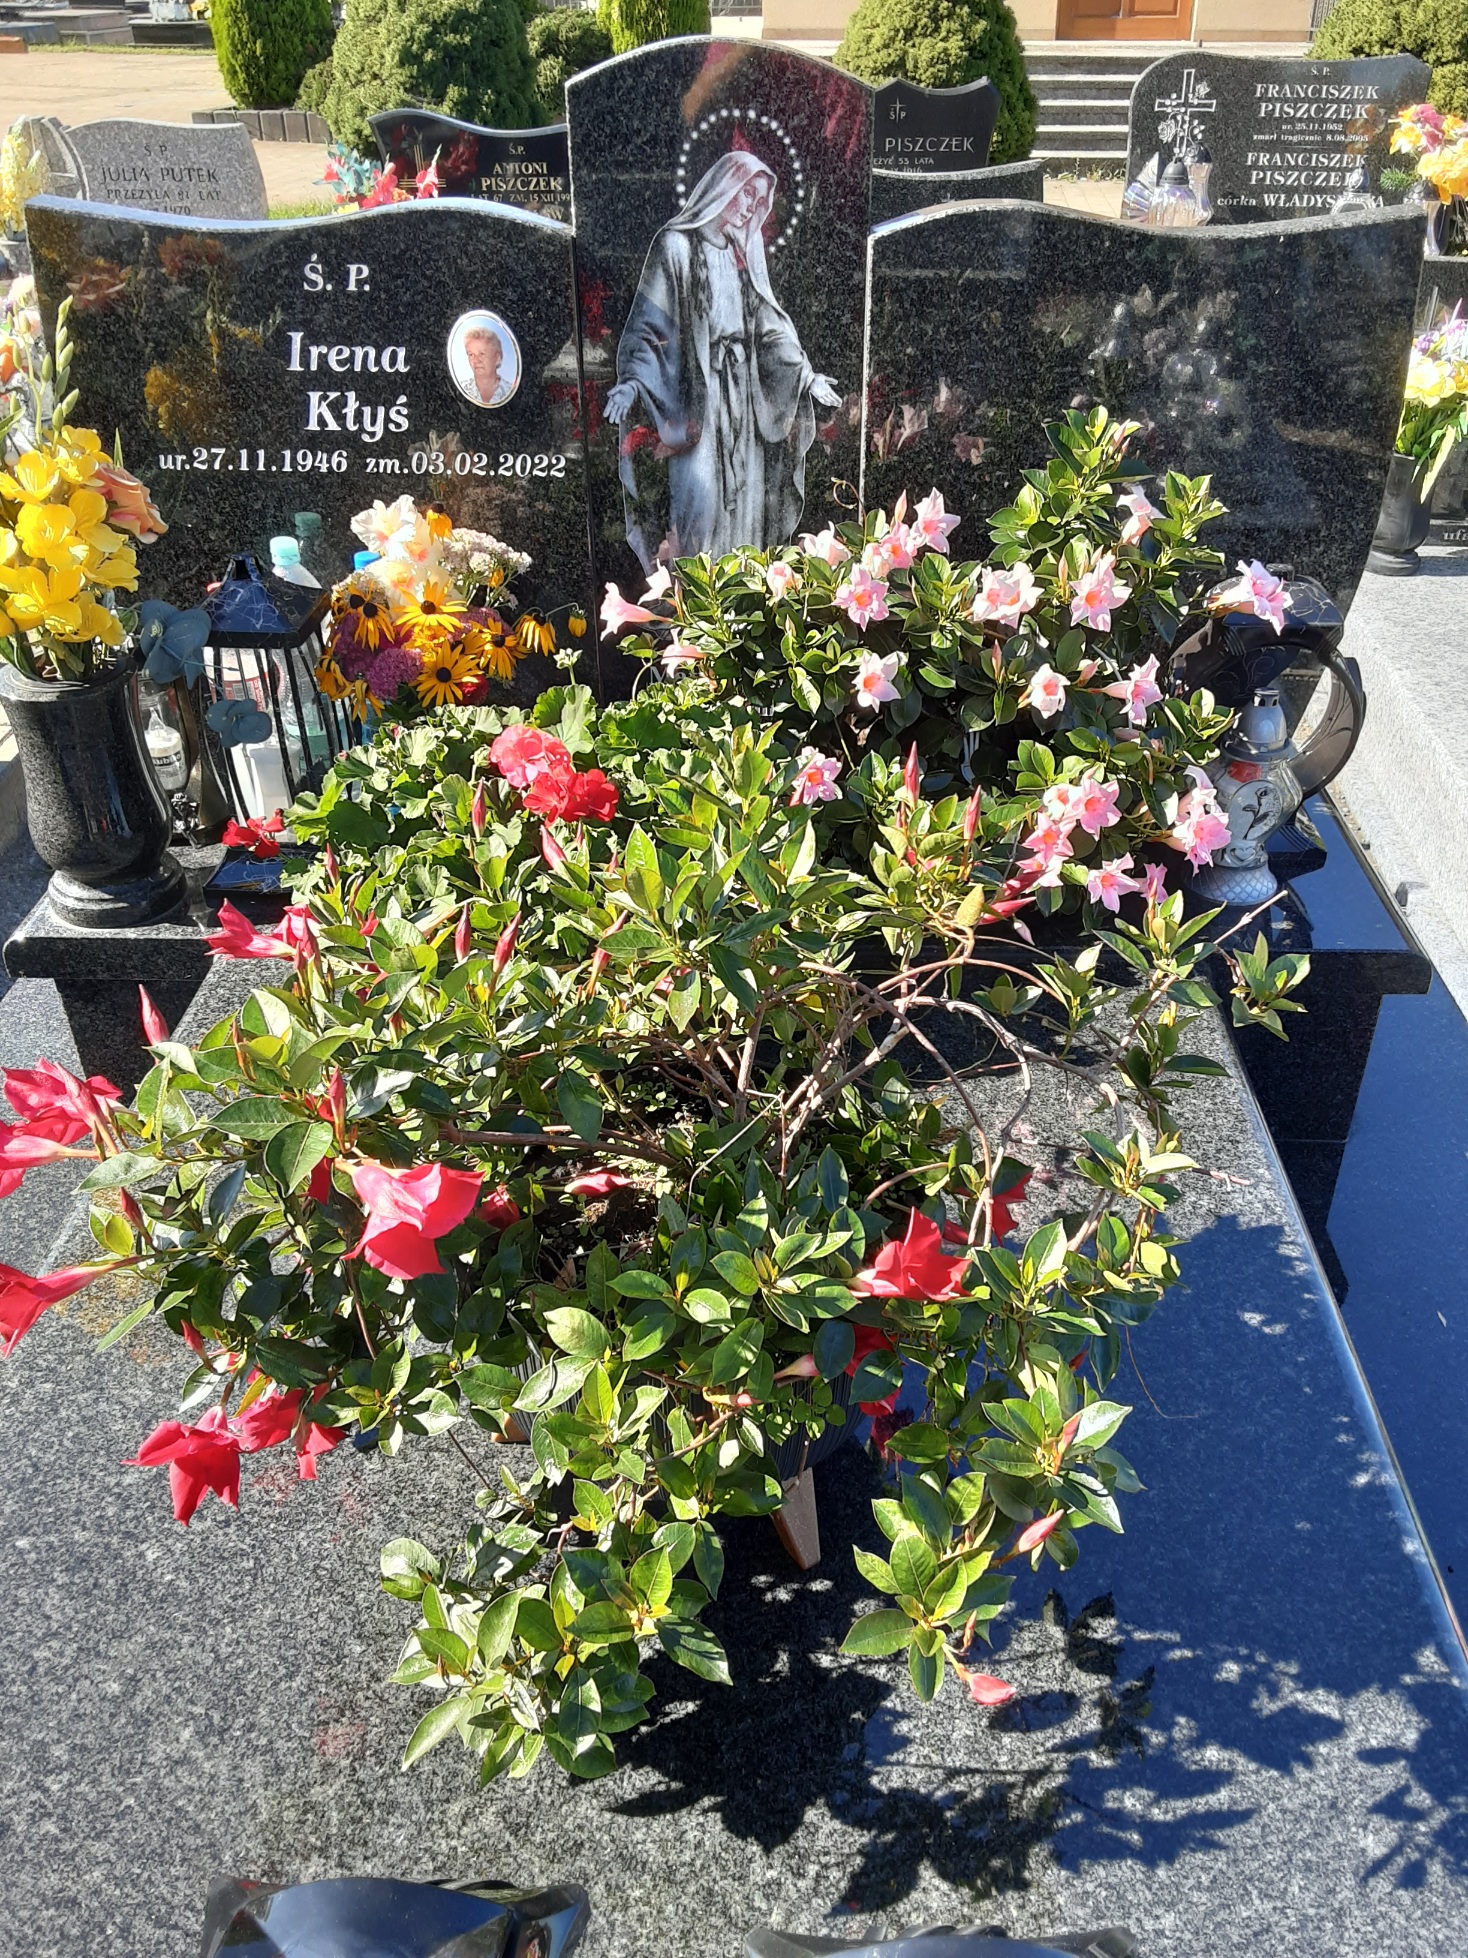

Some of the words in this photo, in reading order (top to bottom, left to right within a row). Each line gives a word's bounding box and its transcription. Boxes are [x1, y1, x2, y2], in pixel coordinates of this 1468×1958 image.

[1254, 83, 1380, 100] FRANCISZEK
[1257, 102, 1371, 120] PISZCZEK
[885, 136, 975, 153] PISZCZEK
[492, 162, 548, 175] ANTONI
[914, 157, 934, 165] LATA
[1245, 152, 1368, 168] FRANCISZEK
[101, 166, 150, 184] JULIA
[161, 167, 221, 183] PUTEK
[481, 176, 563, 192] PISZCZEK
[1217, 195, 1257, 207] córka
[1263, 193, 1384, 208] WŁADYSA
[303, 254, 332, 292] Ś.
[346, 263, 370, 291] P.
[286, 331, 411, 373] Irena
[304, 390, 409, 443] Kłyś
[158, 447, 348, 472] ur.27.11.1946
[365, 450, 566, 478] zm.03.02.2022
